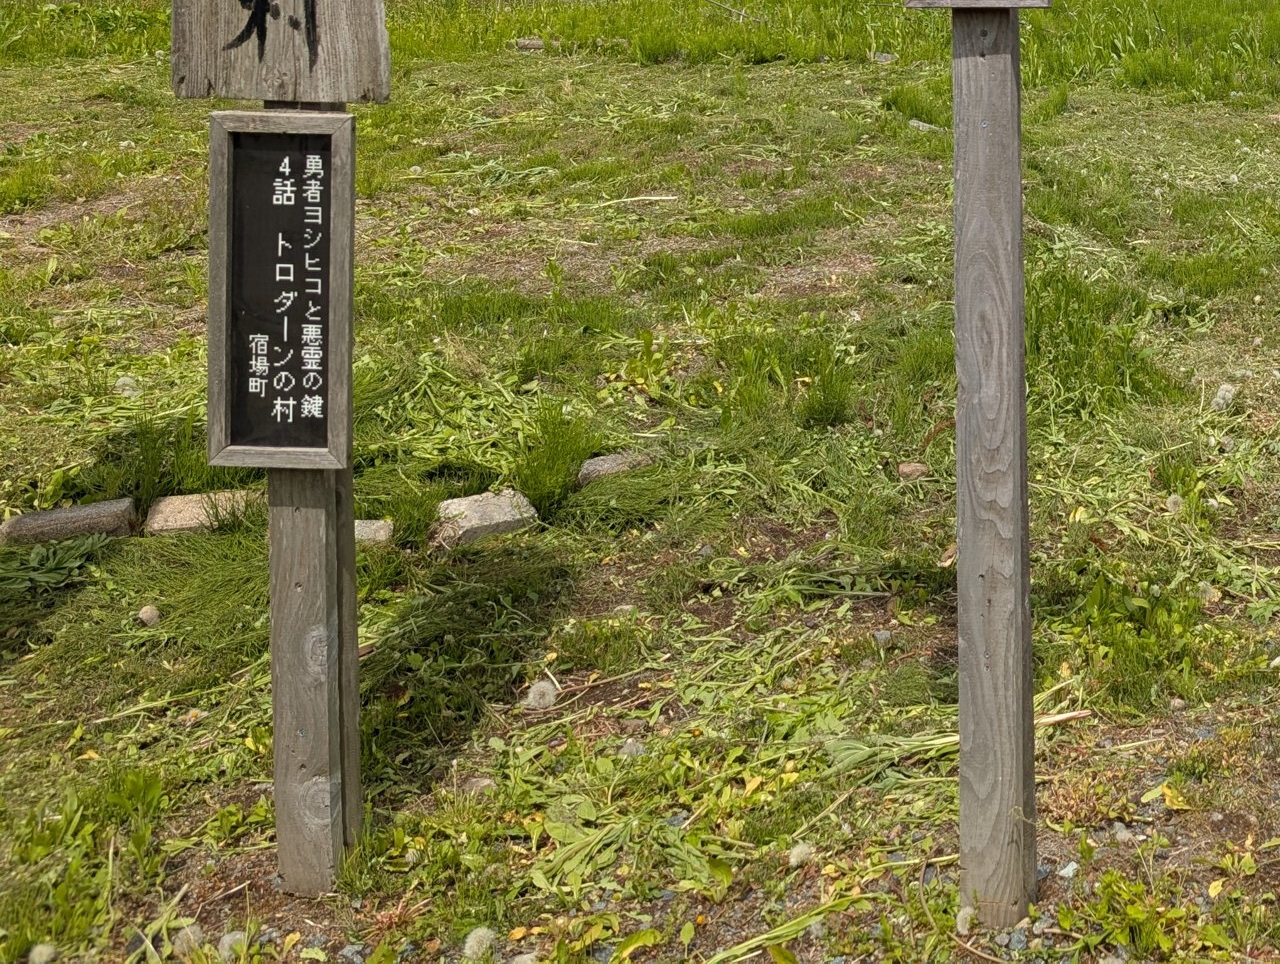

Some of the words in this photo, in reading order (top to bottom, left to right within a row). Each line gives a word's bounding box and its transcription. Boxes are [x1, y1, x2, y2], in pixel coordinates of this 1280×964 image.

[272, 155, 298, 206] 4話
[270, 232, 298, 423] トロダーンの村
[300, 154, 324, 418] 勇者ヨシヒコと悪霊の鍵
[248, 333, 271, 398] 宿場町
